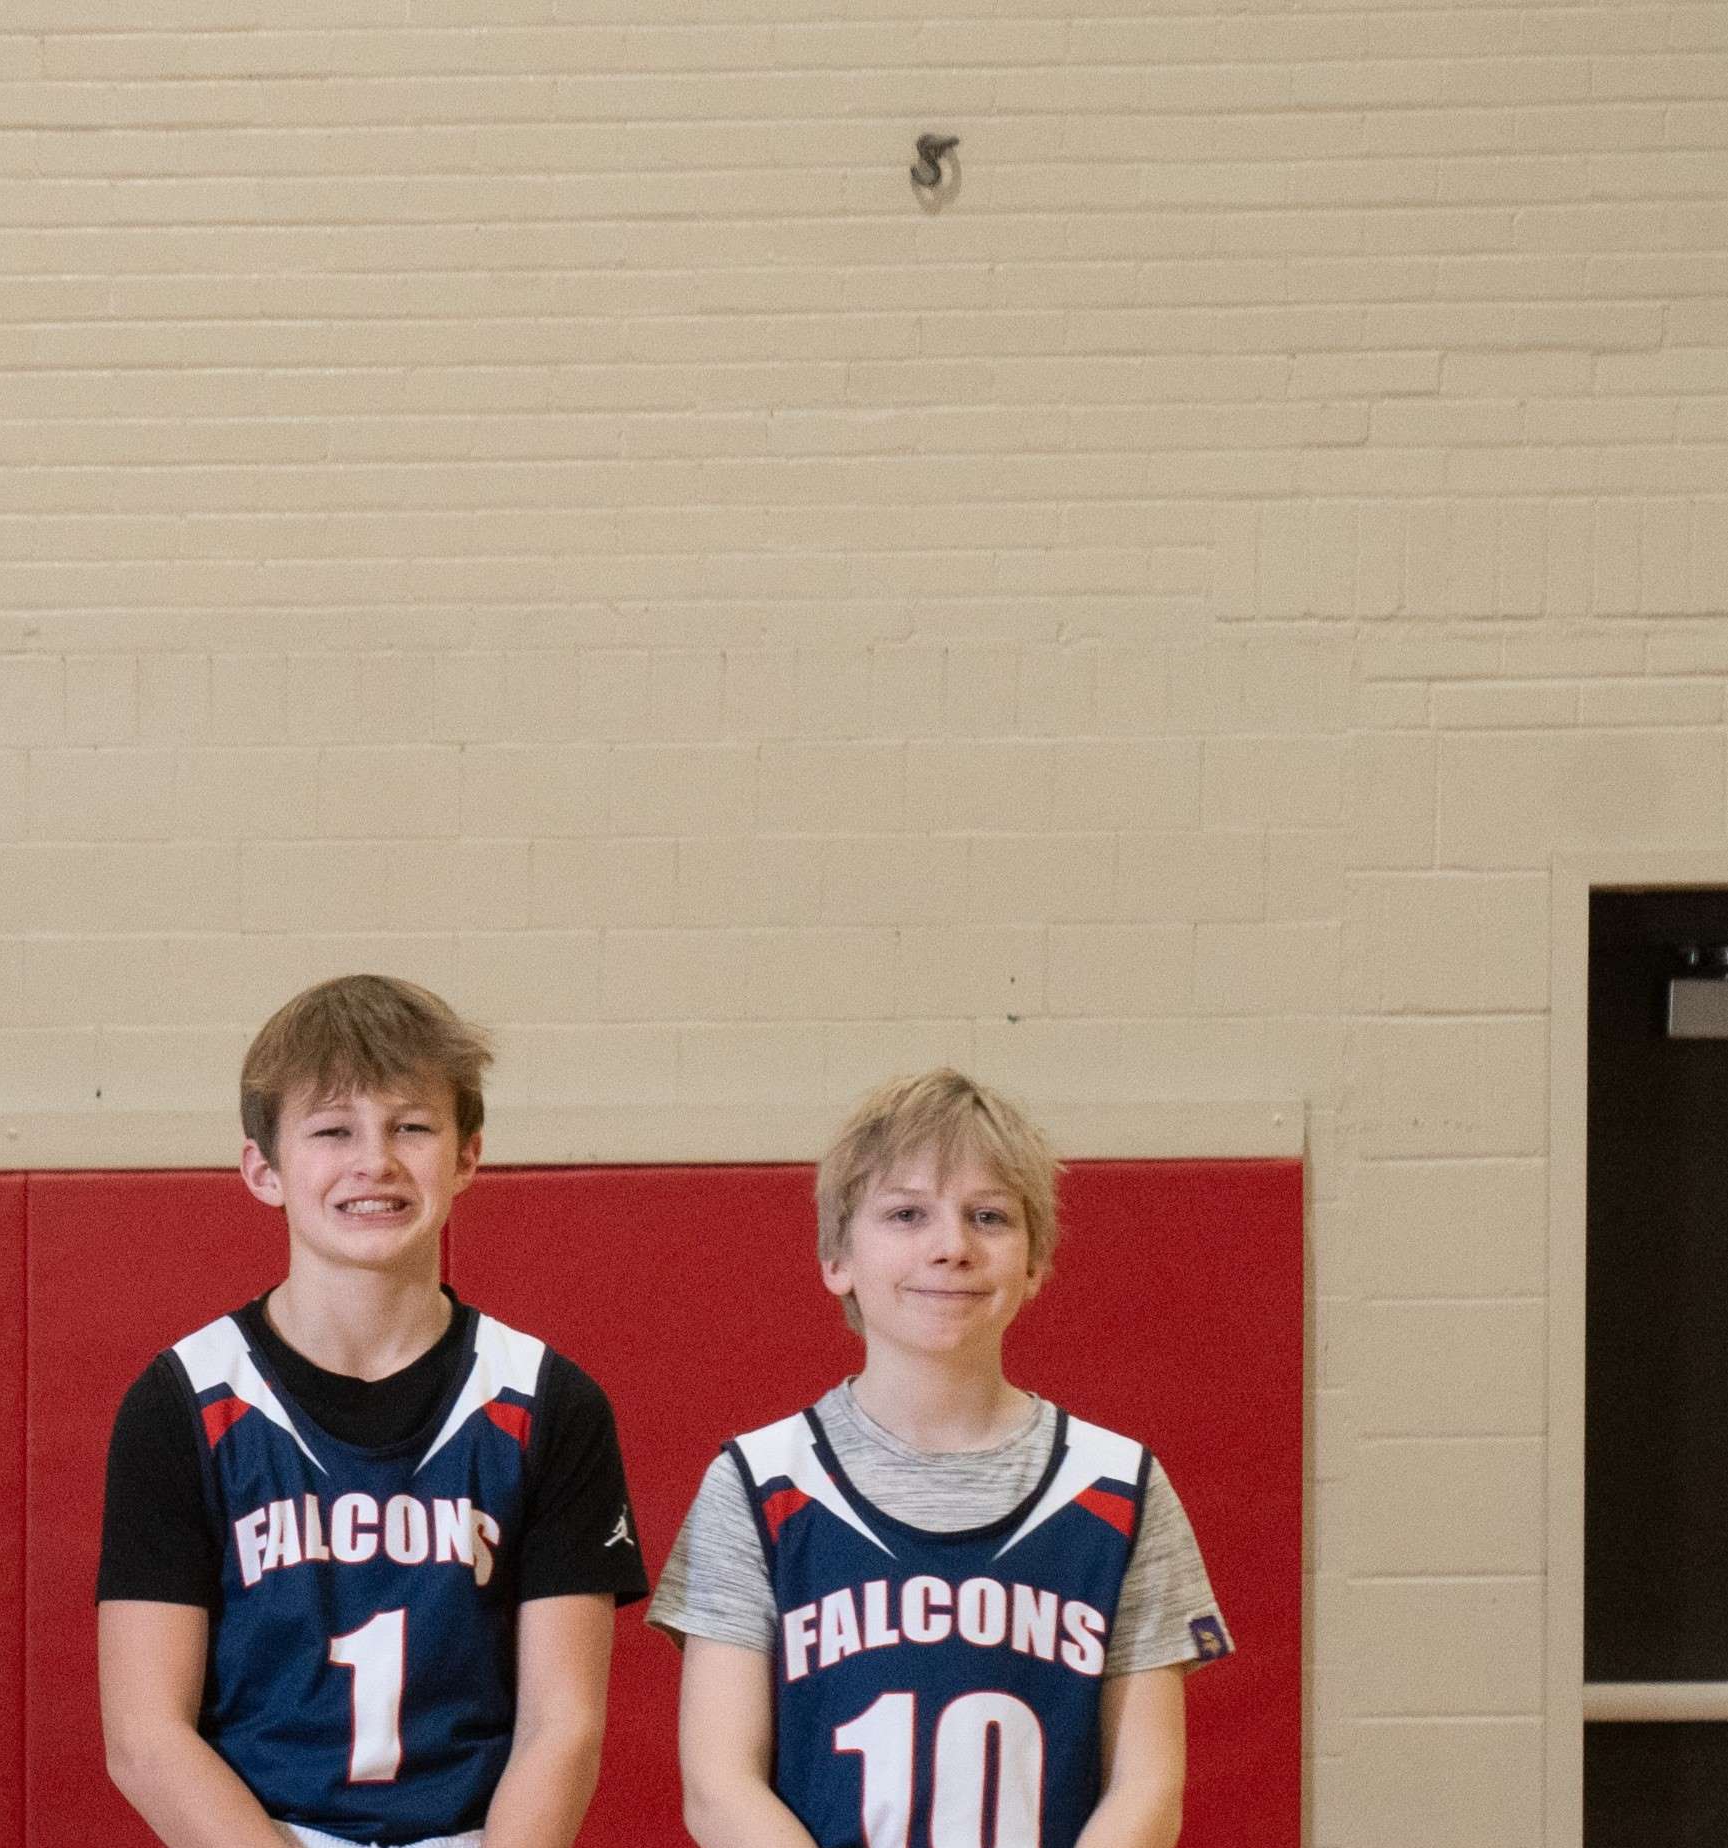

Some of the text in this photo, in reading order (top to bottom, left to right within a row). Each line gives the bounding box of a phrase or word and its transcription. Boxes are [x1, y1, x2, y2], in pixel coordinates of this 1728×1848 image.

[233, 1491, 502, 1589] FALCONS
[782, 1574, 1107, 1683] FALCONS
[327, 1606, 409, 1786] 1
